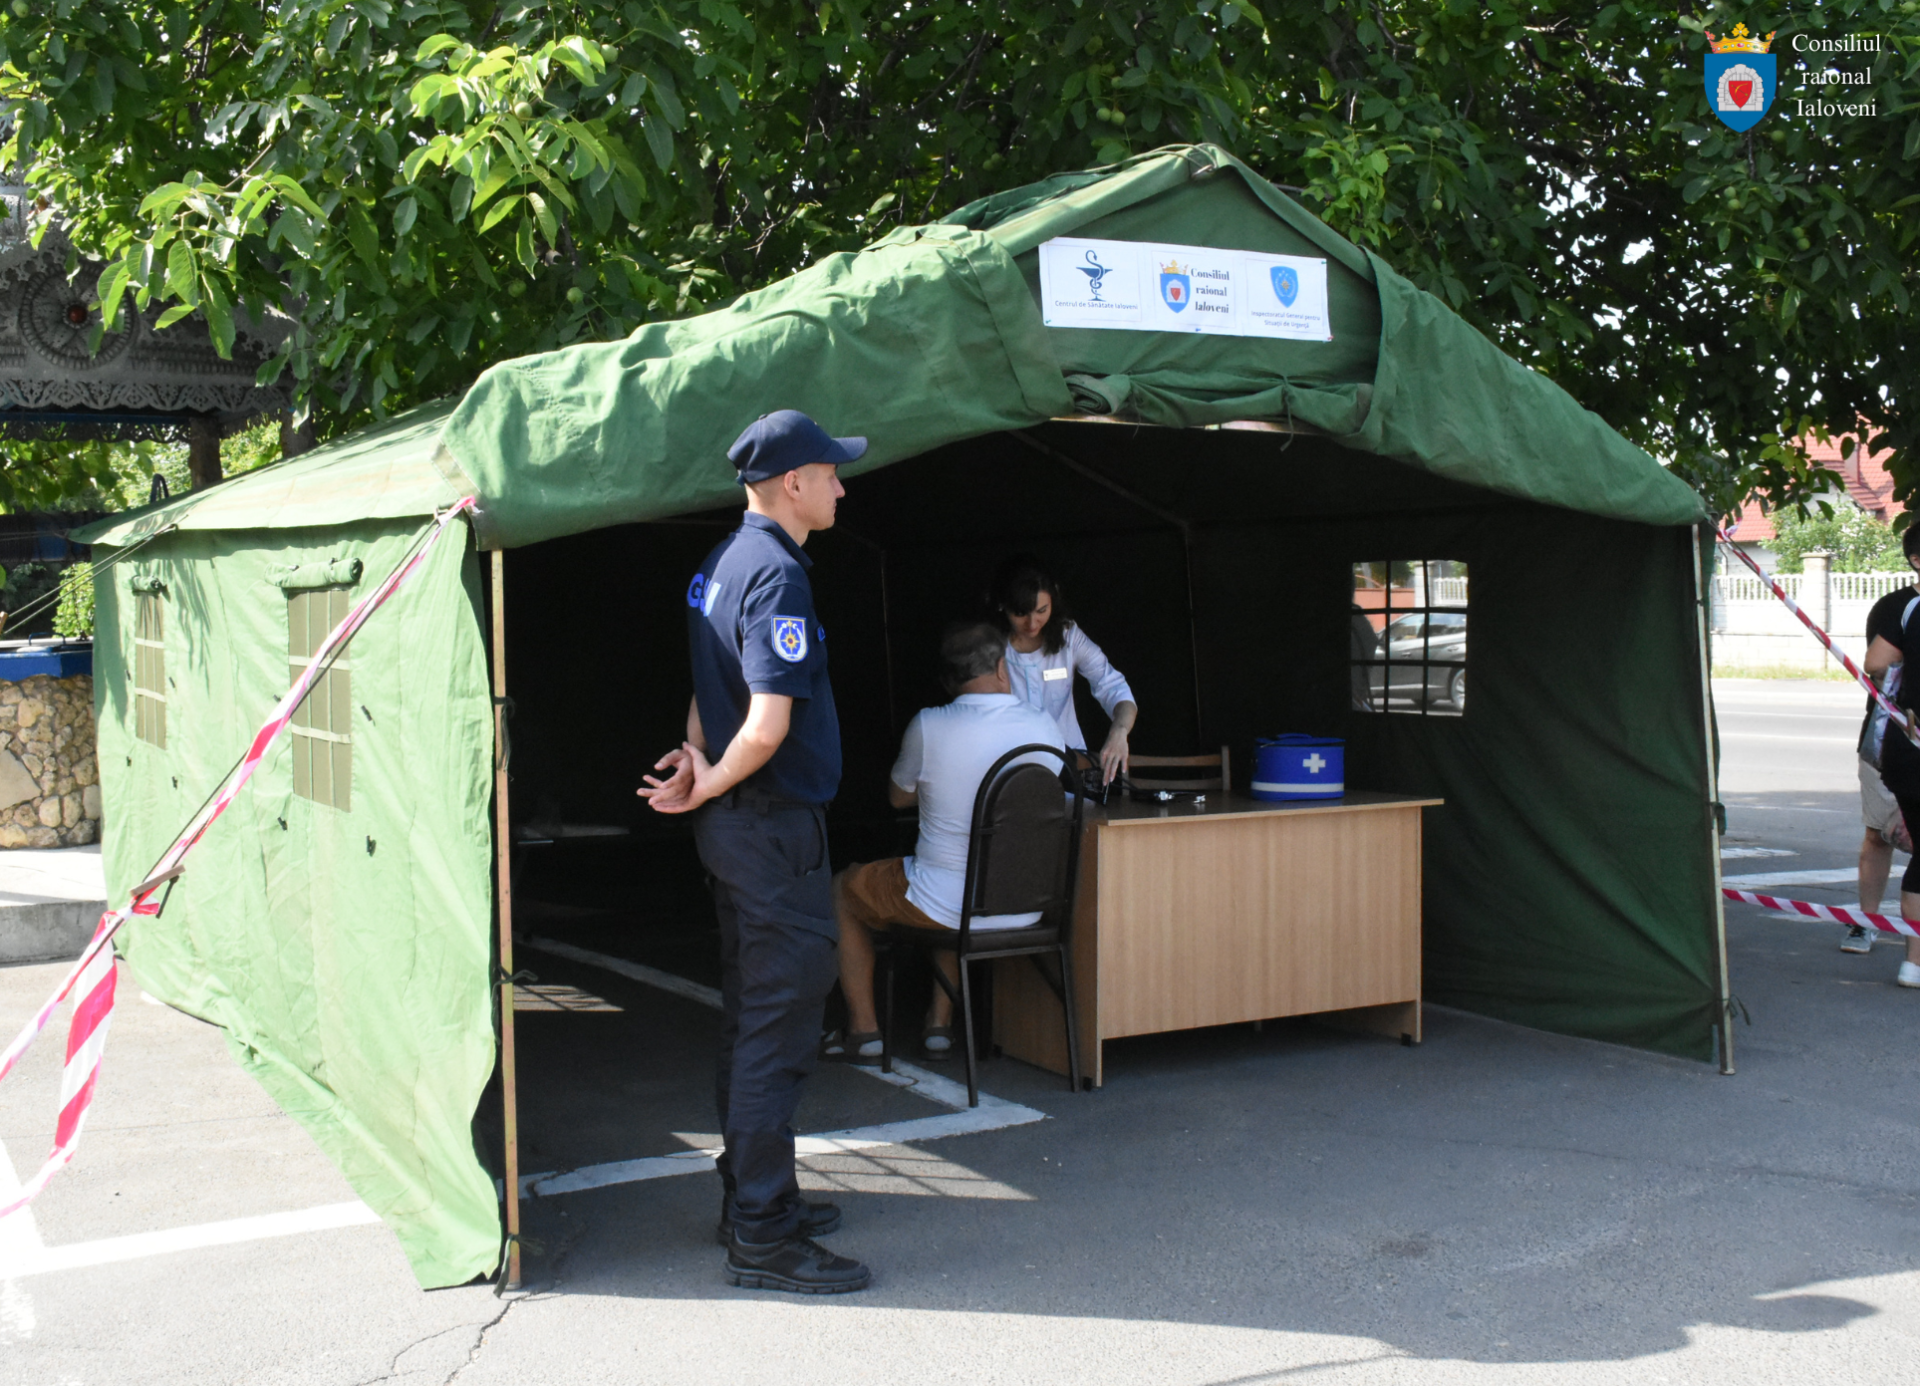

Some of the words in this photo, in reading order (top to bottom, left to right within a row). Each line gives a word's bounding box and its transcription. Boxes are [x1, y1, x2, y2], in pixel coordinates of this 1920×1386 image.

[1190, 267, 1230, 281] Consiliul
[1195, 285, 1227, 297] raional
[1054, 300, 1078, 308] Centrul
[1194, 301, 1230, 314] Ialoveni
